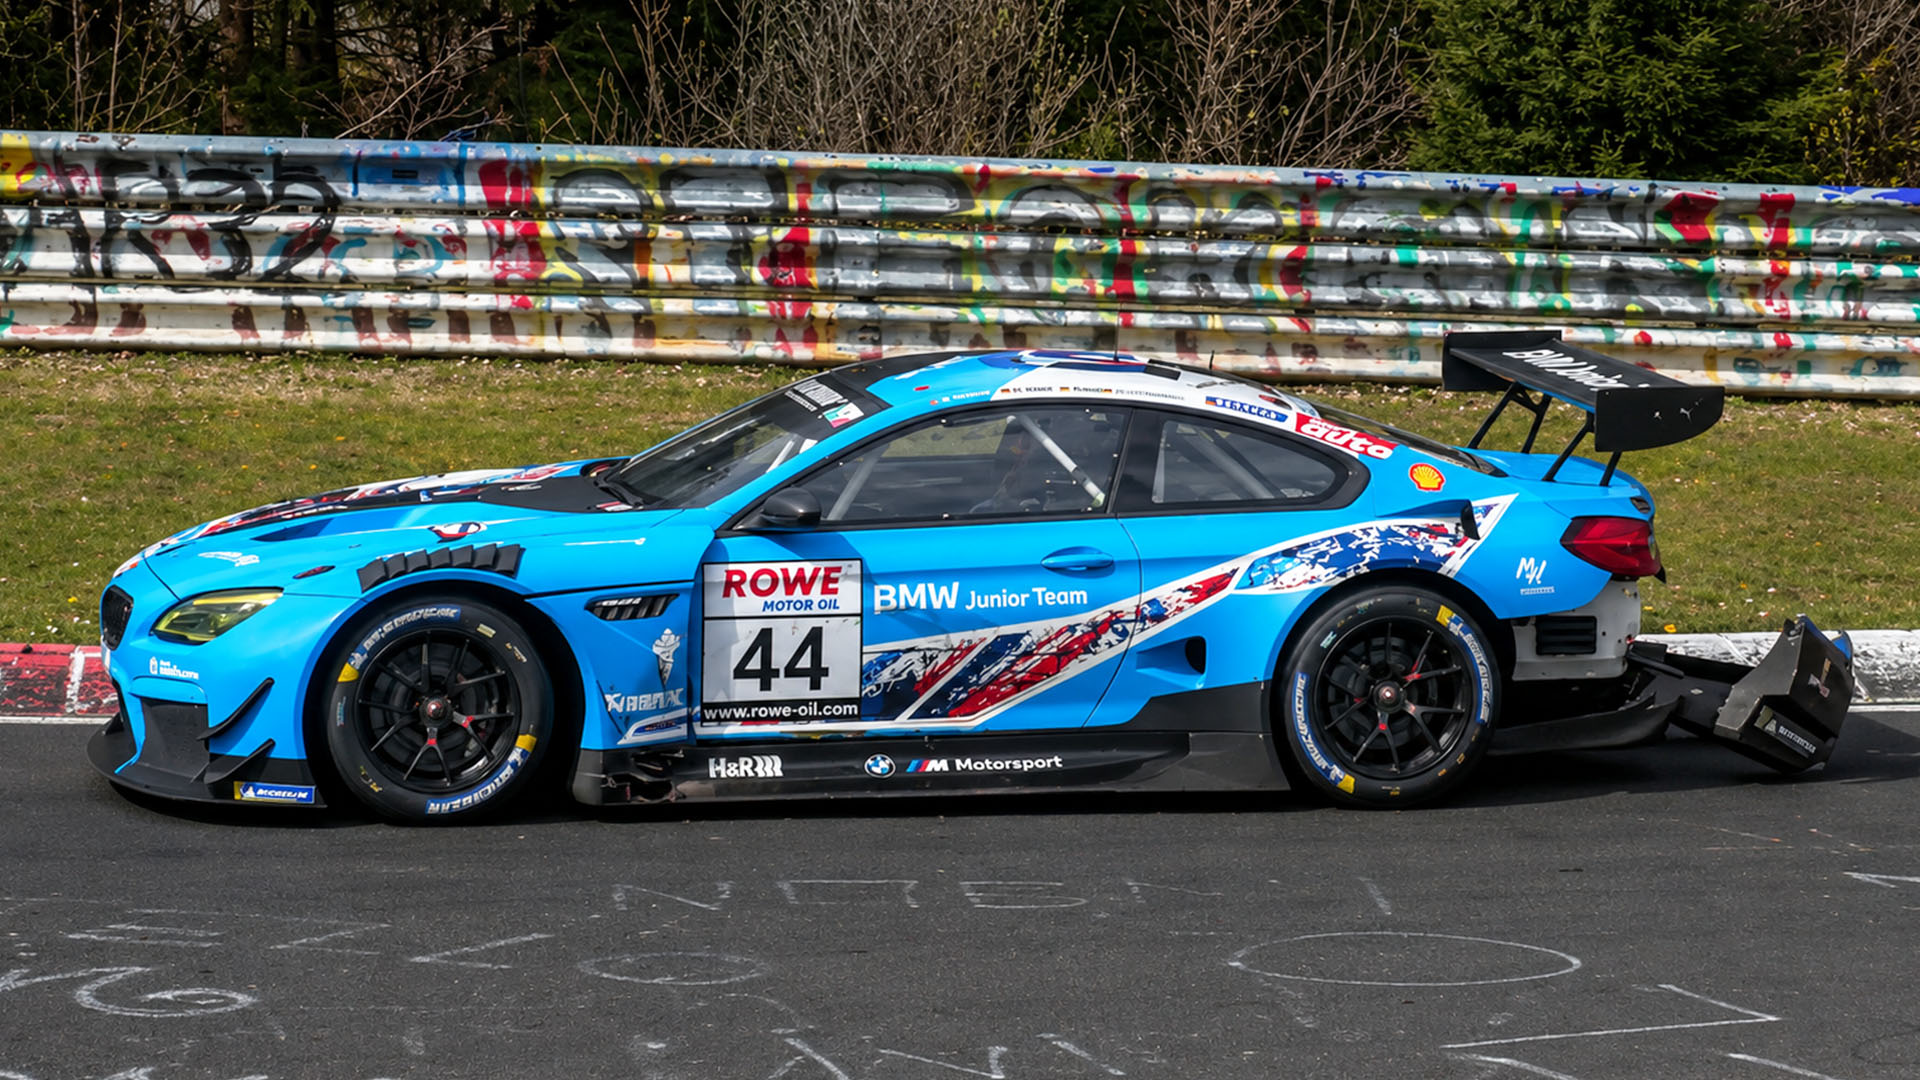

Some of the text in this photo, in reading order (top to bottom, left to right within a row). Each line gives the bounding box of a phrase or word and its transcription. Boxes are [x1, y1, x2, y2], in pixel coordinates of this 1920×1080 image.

[1301, 424, 1394, 460] auto
[722, 566, 843, 598] ROWE
[873, 581, 1088, 615] BMW Junior Team
[762, 598, 840, 612] MOTOR OIL
[733, 626, 829, 692] 44
[704, 701, 858, 720] www.rowe-oil.com
[955, 755, 1064, 772] Motorsport
